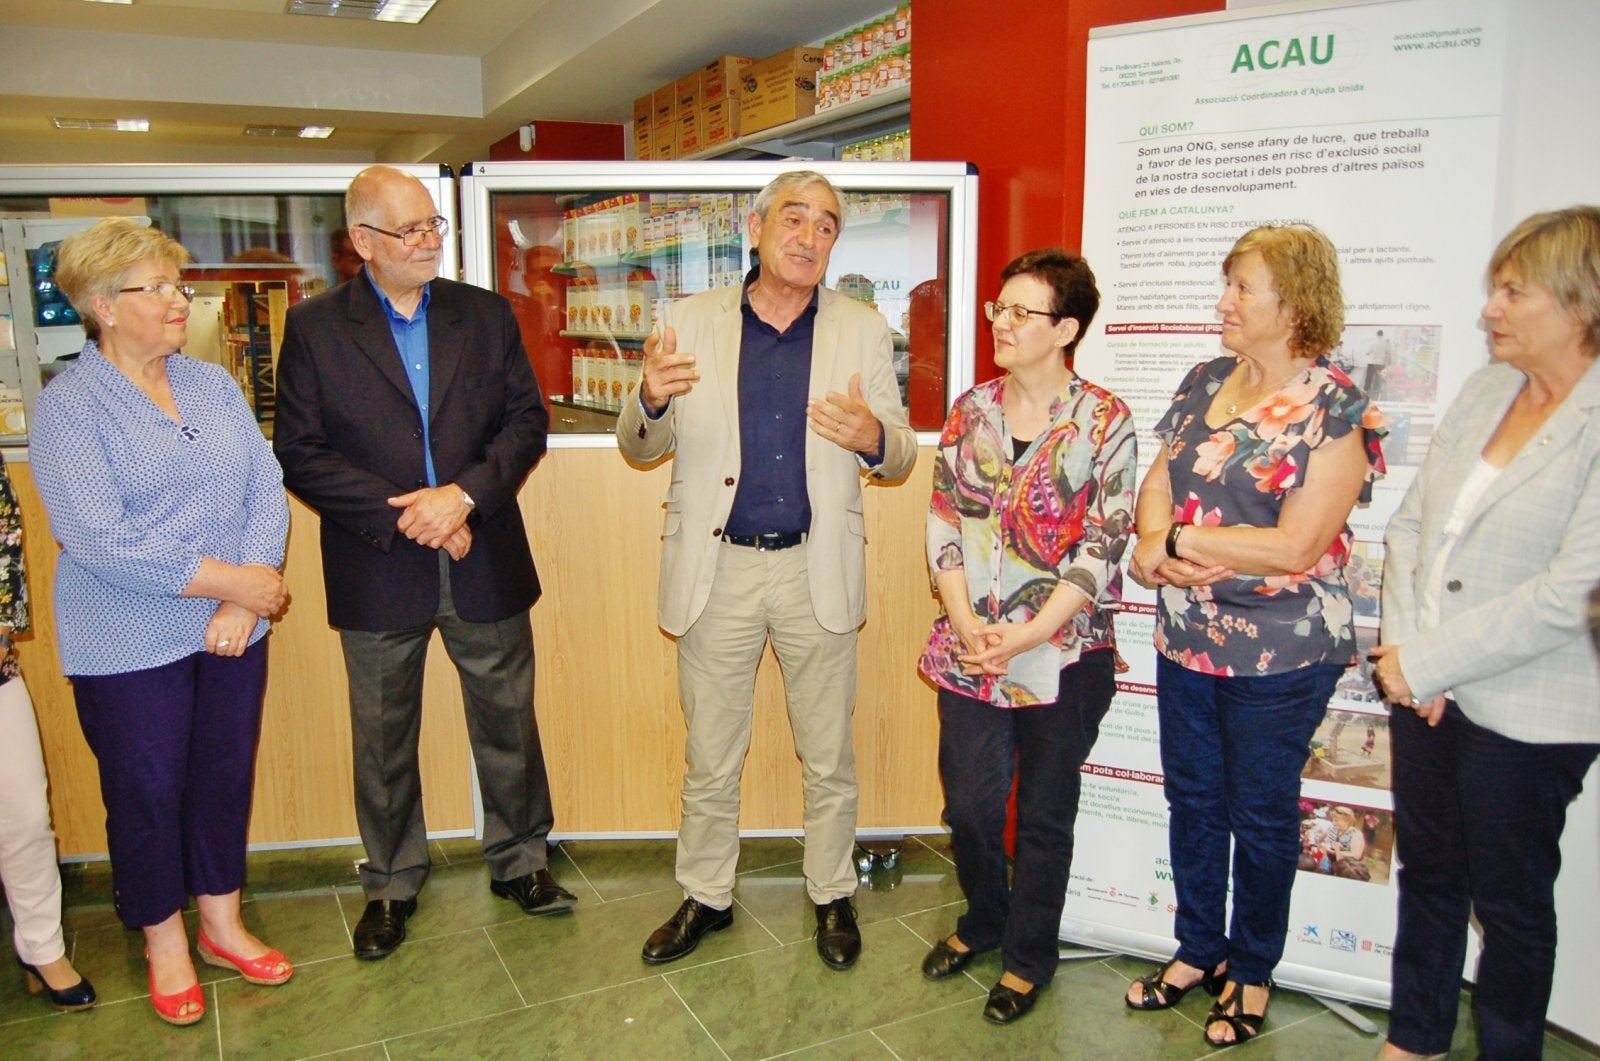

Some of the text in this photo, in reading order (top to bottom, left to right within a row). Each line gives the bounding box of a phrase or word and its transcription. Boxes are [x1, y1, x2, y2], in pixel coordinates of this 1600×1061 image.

[1394, 37, 1481, 51] www.acau.org
[1230, 34, 1334, 73] ACAU
[1194, 94, 1239, 105] Associació
[1241, 88, 1298, 102] Coordinadora
[1338, 83, 1364, 94] Unida
[1139, 122, 1194, 136] QUI SOM?
[1138, 128, 1430, 157] Som una ONG, sense afany de lucre, que treballa
[1136, 144, 1422, 171] a favor de les persones en risc d'exclusió social
[480, 166, 485, 174] 4
[1136, 175, 1148, 185] de
[1150, 174, 1160, 182] la
[1162, 171, 1198, 182] nostra
[1202, 168, 1248, 180] societat
[1258, 165, 1282, 176] dels
[1285, 163, 1328, 176] pobres
[1332, 161, 1378, 173] d'altres
[1382, 159, 1424, 172] països
[1134, 180, 1297, 199] en vies de desenvolupament.
[1140, 208, 1158, 218] FEM
[1160, 208, 1167, 216] A
[1170, 205, 1234, 215] CATALUNYA?
[1154, 222, 1195, 230] PERSONES
[1350, 256, 1372, 264] altres
[872, 280, 900, 290] CAU
[1138, 606, 1156, 614] prom
[1093, 766, 1113, 776] pots
